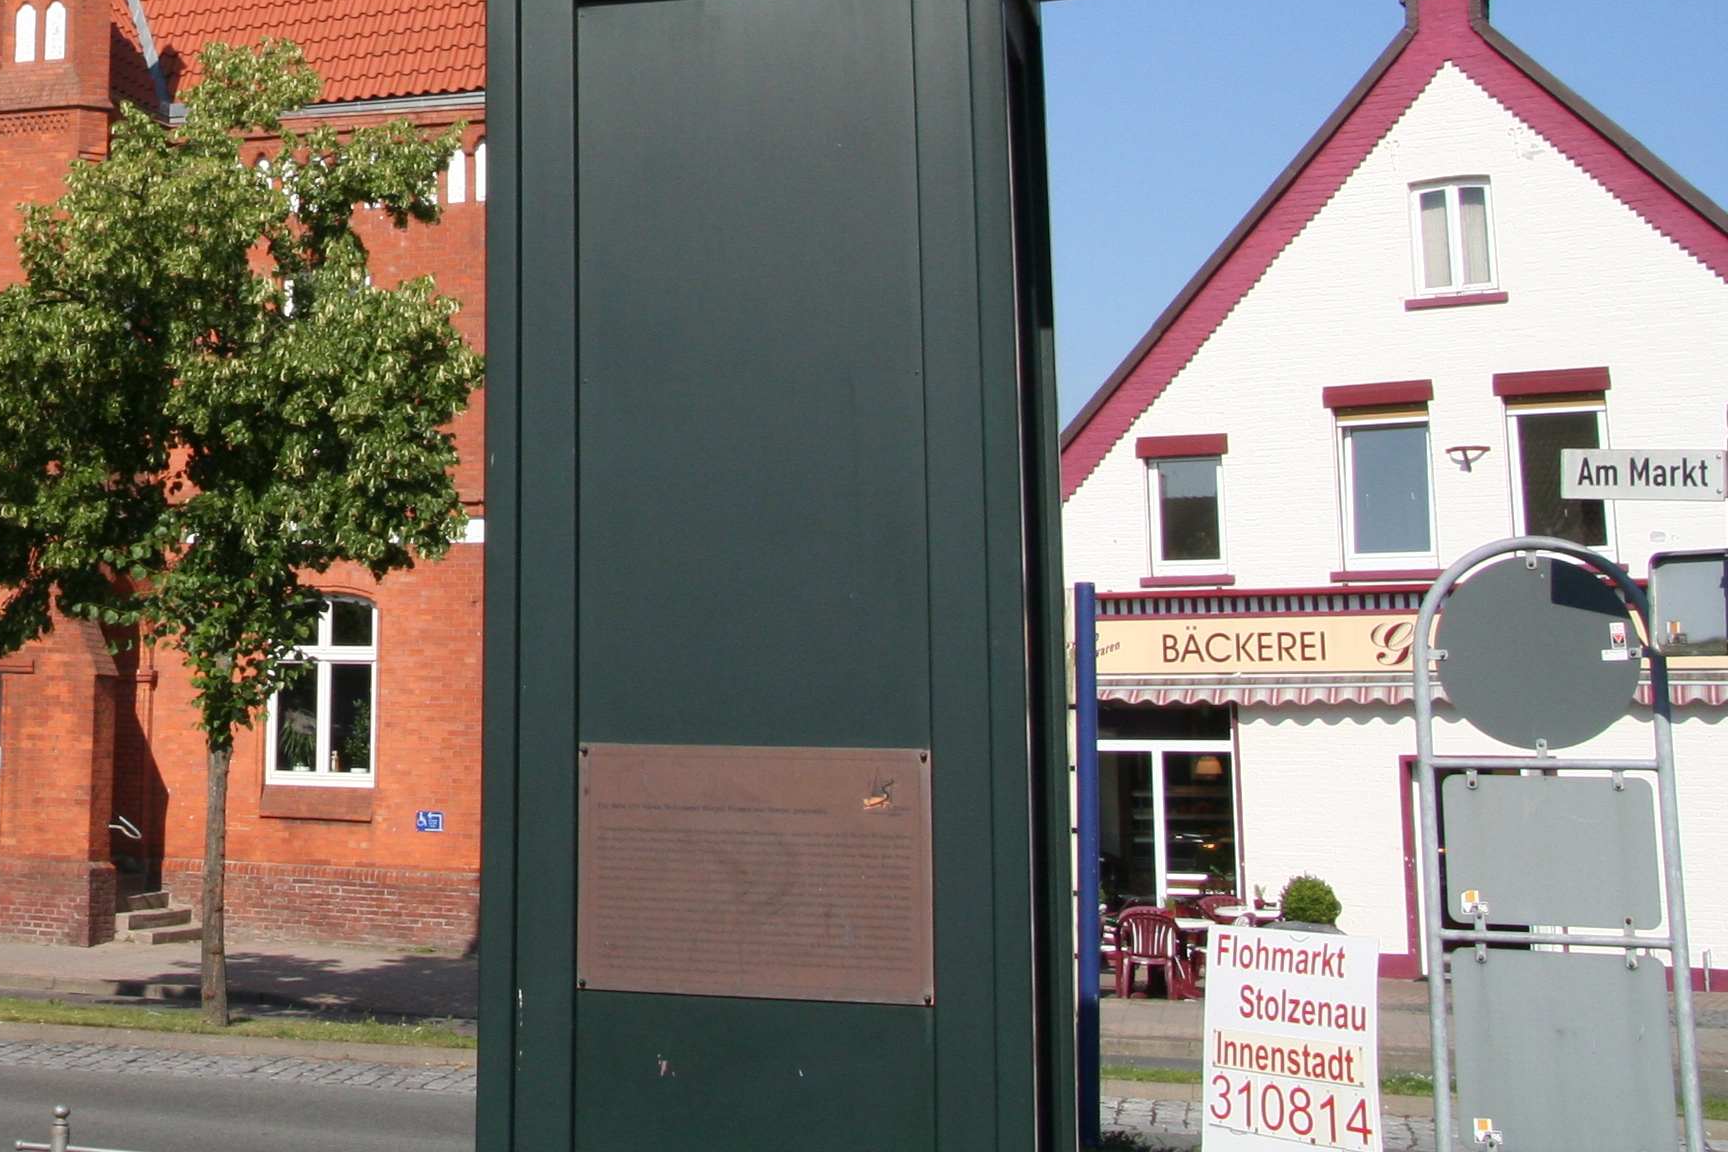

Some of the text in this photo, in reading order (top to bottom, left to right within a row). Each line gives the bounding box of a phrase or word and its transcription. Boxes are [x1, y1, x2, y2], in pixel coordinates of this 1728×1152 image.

[1577, 457, 1708, 487] Am Markt
[1161, 625, 1327, 663] BÄCKEREI
[1216, 933, 1346, 978] Flohmarkt
[1239, 983, 1366, 1032] Stolzenau
[1216, 1030, 1355, 1084] Innenstadt
